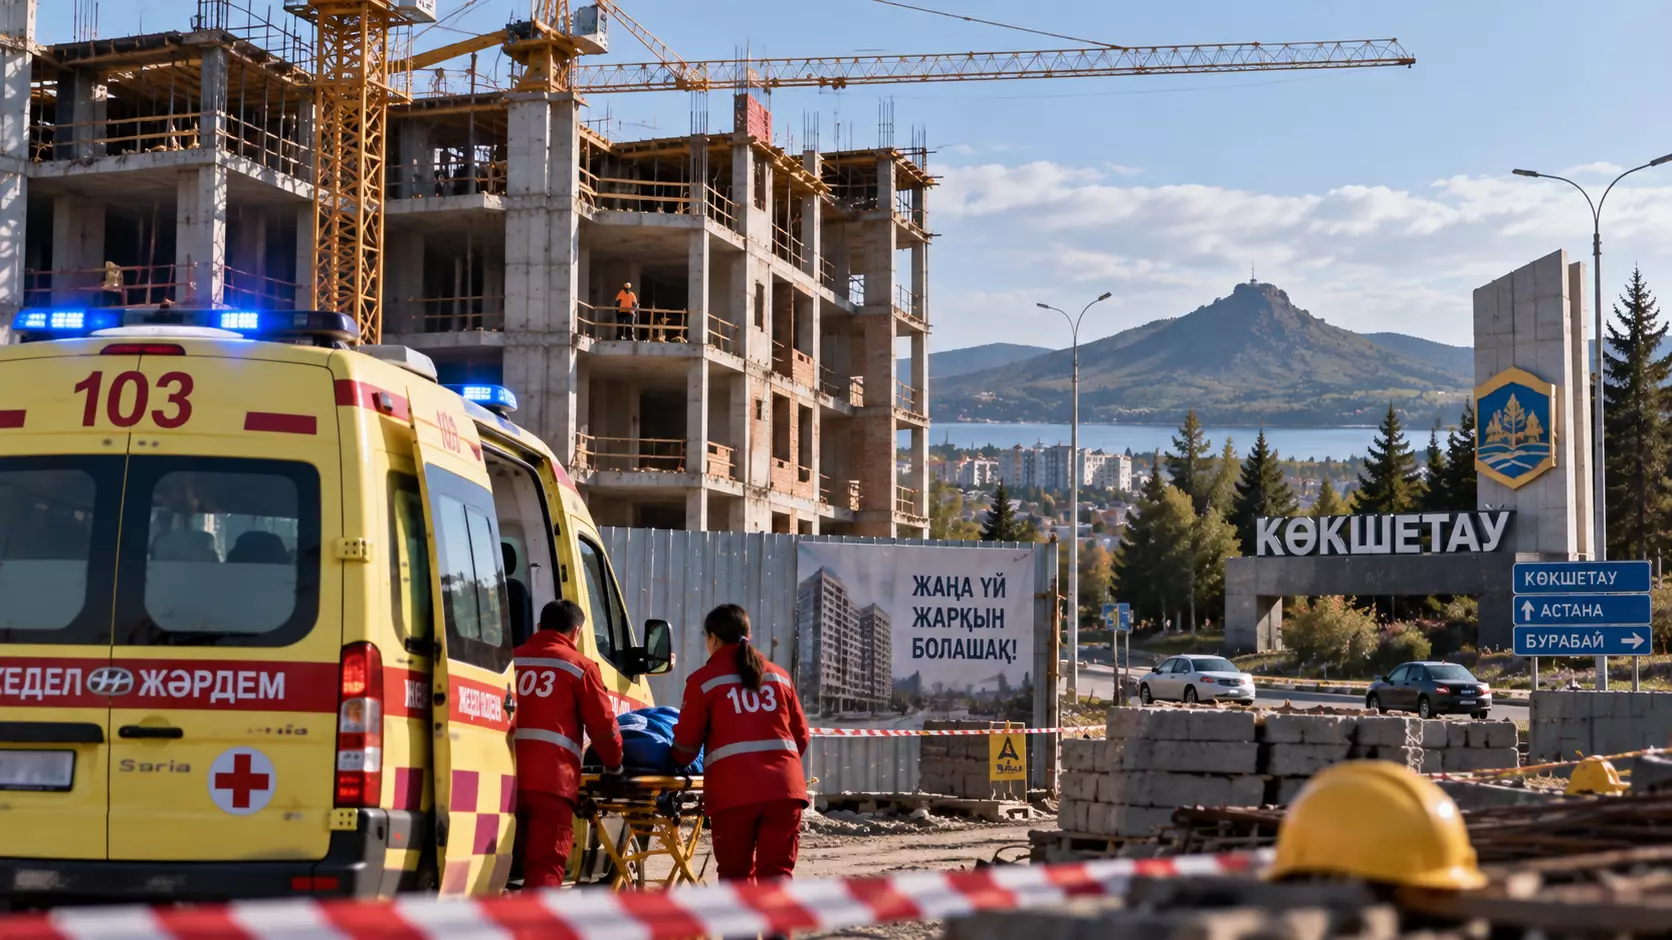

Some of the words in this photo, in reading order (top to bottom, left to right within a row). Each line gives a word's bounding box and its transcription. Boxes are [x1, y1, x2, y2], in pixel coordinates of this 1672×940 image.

[74, 370, 194, 429] 103
[912, 575, 974, 601] ЖАҢА
[980, 572, 1006, 599] ҮЙ
[1525, 571, 1617, 586] КӨКШЕТАУ
[912, 607, 1004, 633] ЖАРҚЫН
[1540, 604, 1604, 617] АСТАНА
[912, 637, 1017, 664] БОЛАШАҚ!
[1526, 630, 1604, 648] БУРАБАЙ
[138, 669, 286, 703] ЖӘРДЕМ
[515, 670, 556, 697] 03
[727, 684, 778, 714] 103
